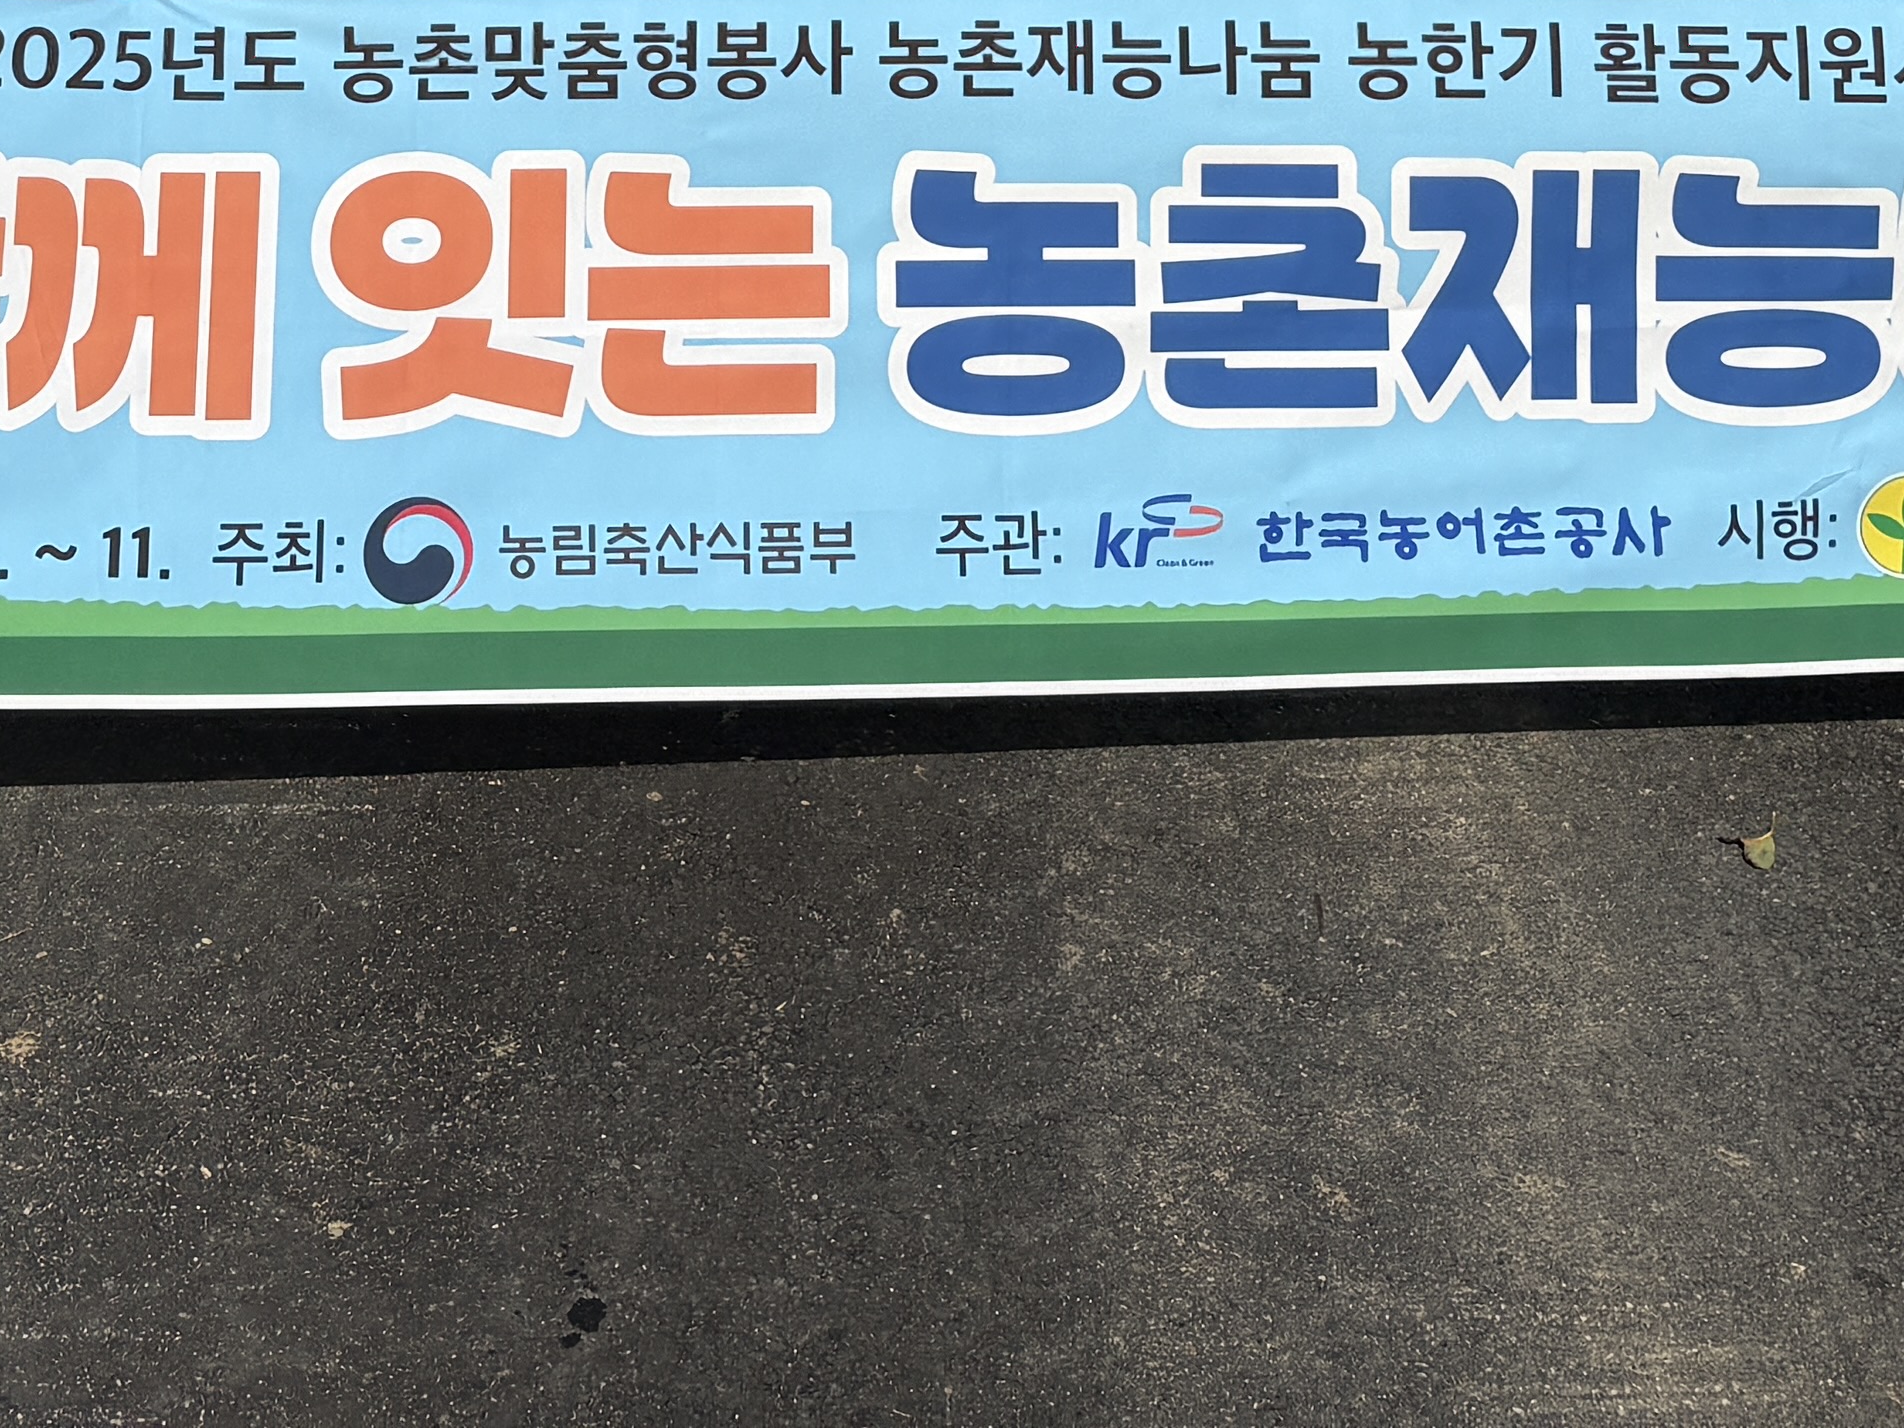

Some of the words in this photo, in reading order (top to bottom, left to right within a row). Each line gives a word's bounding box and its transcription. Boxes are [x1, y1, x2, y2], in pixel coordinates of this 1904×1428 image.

[332, 20, 855, 105] 농촌맞춤형봉사
[877, 19, 1322, 101] 농촌재능나눔
[1347, 21, 1563, 102] 농한기
[329, 167, 832, 422] 잇는
[101, 525, 171, 581] 11.
[211, 518, 346, 587] 주최:
[497, 520, 857, 580] 농림축산식품부
[934, 509, 1063, 578] 주관:
[1254, 504, 1673, 563] 한국농어촌공사
[1716, 497, 1838, 562] 시행:
